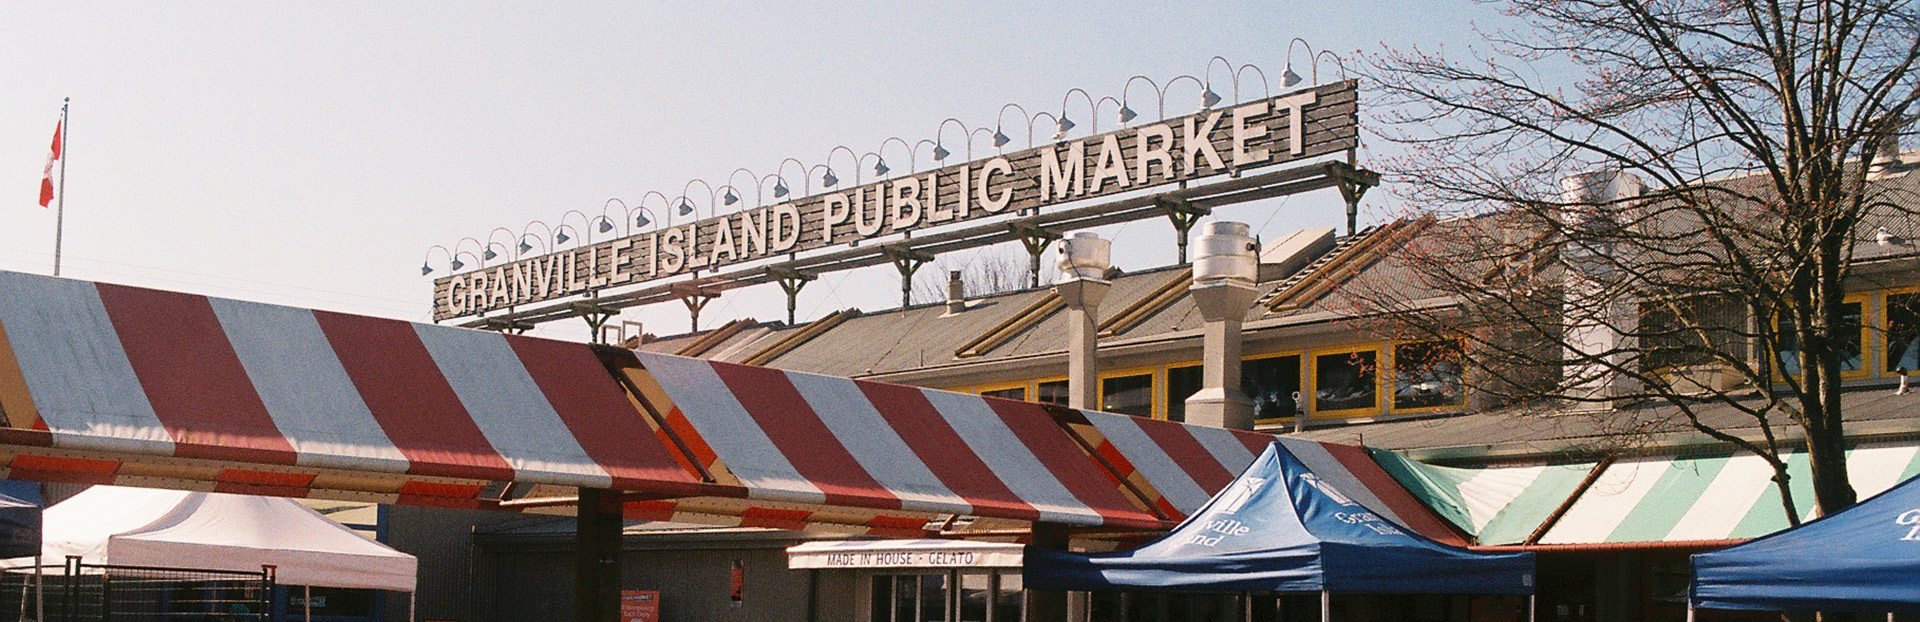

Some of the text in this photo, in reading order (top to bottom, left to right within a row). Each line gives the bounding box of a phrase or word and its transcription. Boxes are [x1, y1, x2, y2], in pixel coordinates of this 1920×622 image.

[448, 91, 1318, 316] GRANVILLE ISLAND PUBLIC MARKET
[827, 553, 855, 566] MADE
[860, 553, 871, 565] IN
[876, 552, 913, 565] HOUSE
[929, 551, 974, 565] GELATO
